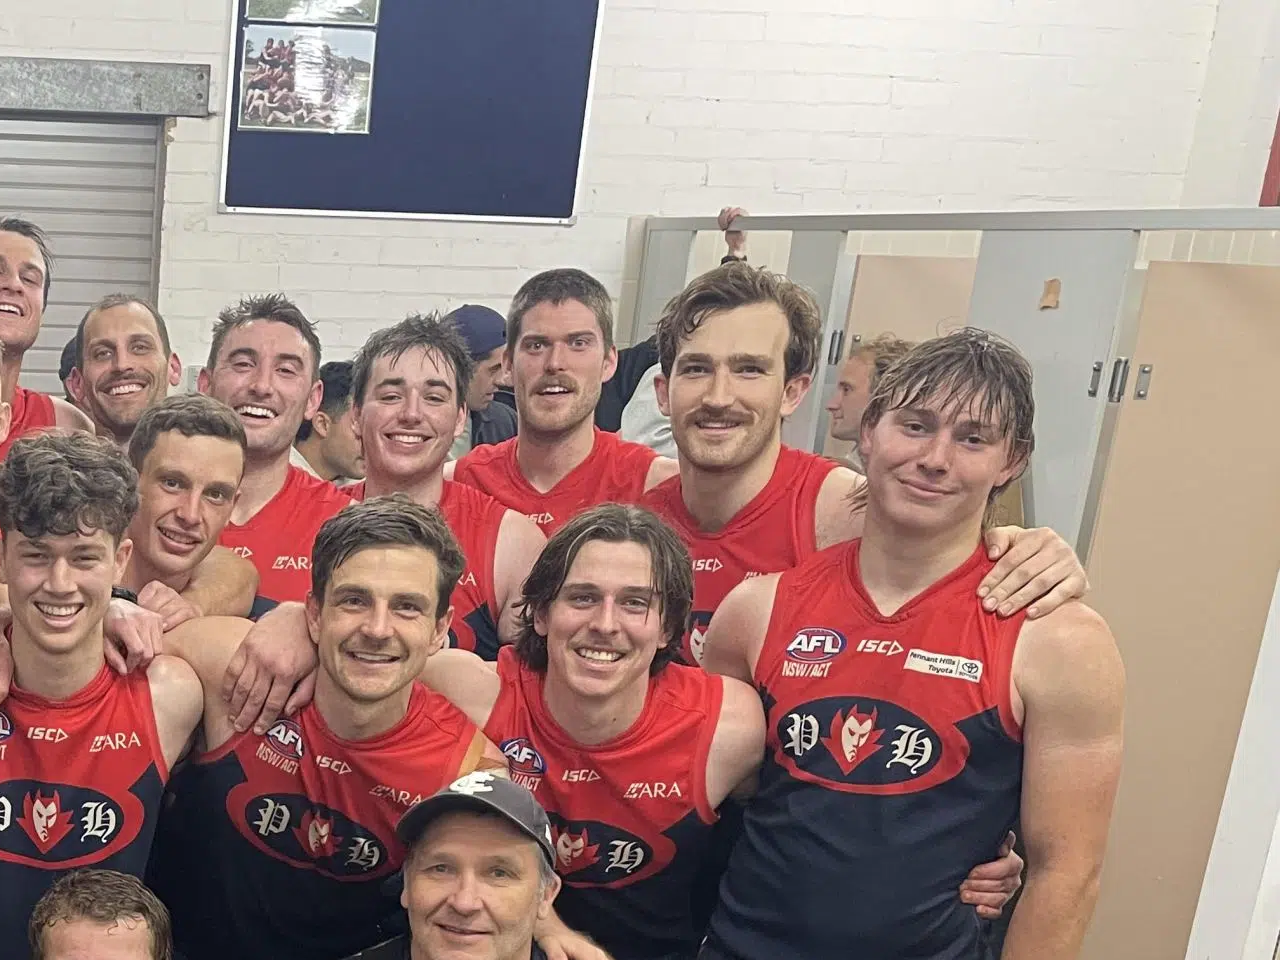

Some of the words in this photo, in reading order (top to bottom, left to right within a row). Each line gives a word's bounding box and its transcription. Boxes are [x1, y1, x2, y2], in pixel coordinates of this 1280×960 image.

[786, 634, 841, 653] AFL
[782, 660, 833, 678] NSW/ACT
[255, 742, 301, 776] NSW/ACT
